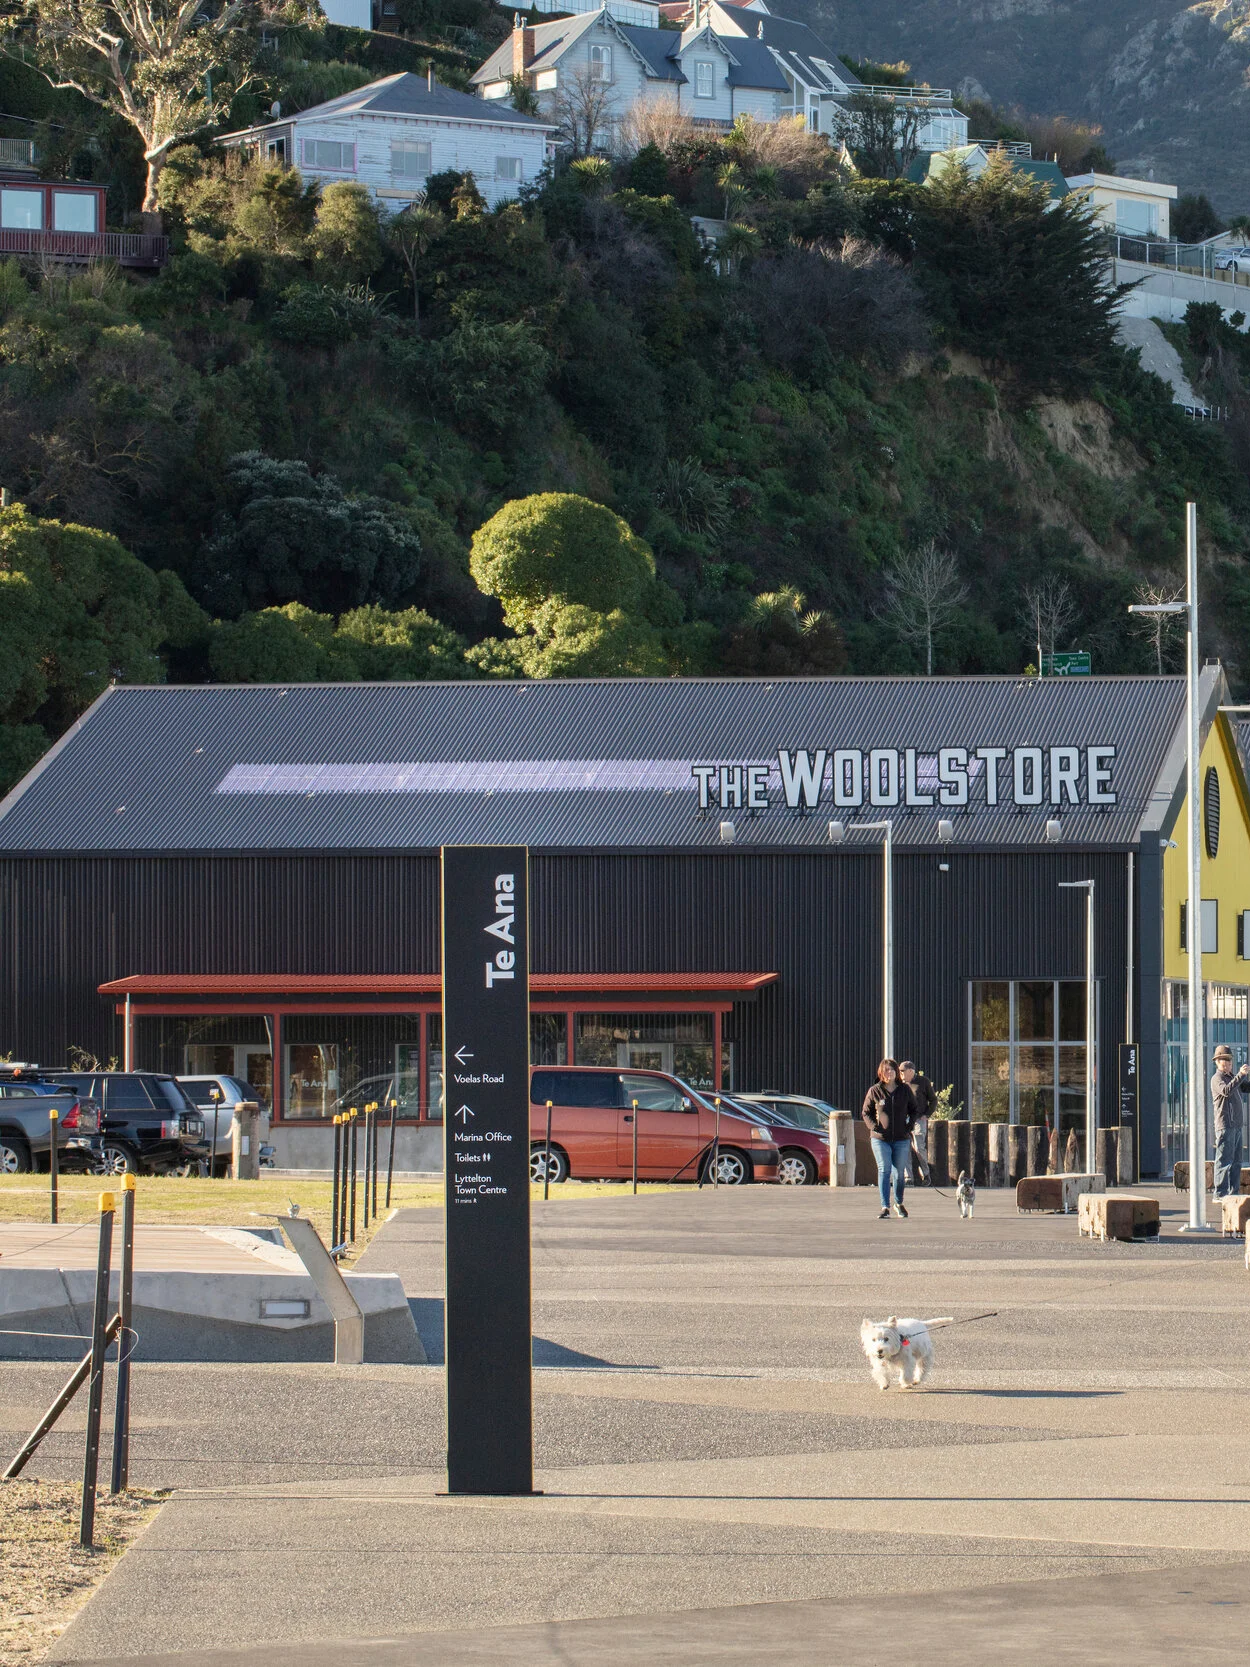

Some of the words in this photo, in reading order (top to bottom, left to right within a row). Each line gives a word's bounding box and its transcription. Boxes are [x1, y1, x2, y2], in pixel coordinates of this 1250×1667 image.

[692, 766, 769, 809] THE
[777, 746, 1118, 808] WOOLSTORE
[484, 874, 515, 945] Ana
[486, 950, 515, 988] Te
[1128, 1050, 1136, 1065] Ana
[1128, 1066, 1136, 1075] Te
[453, 1074, 481, 1083] Voelas
[482, 1073, 504, 1083] Road
[454, 1132, 483, 1142] Marina
[484, 1131, 513, 1142] Office
[454, 1152, 481, 1162] Toilets
[454, 1173, 492, 1184] Lyttelton
[454, 1184, 477, 1194] Town
[478, 1184, 507, 1194] Centre
